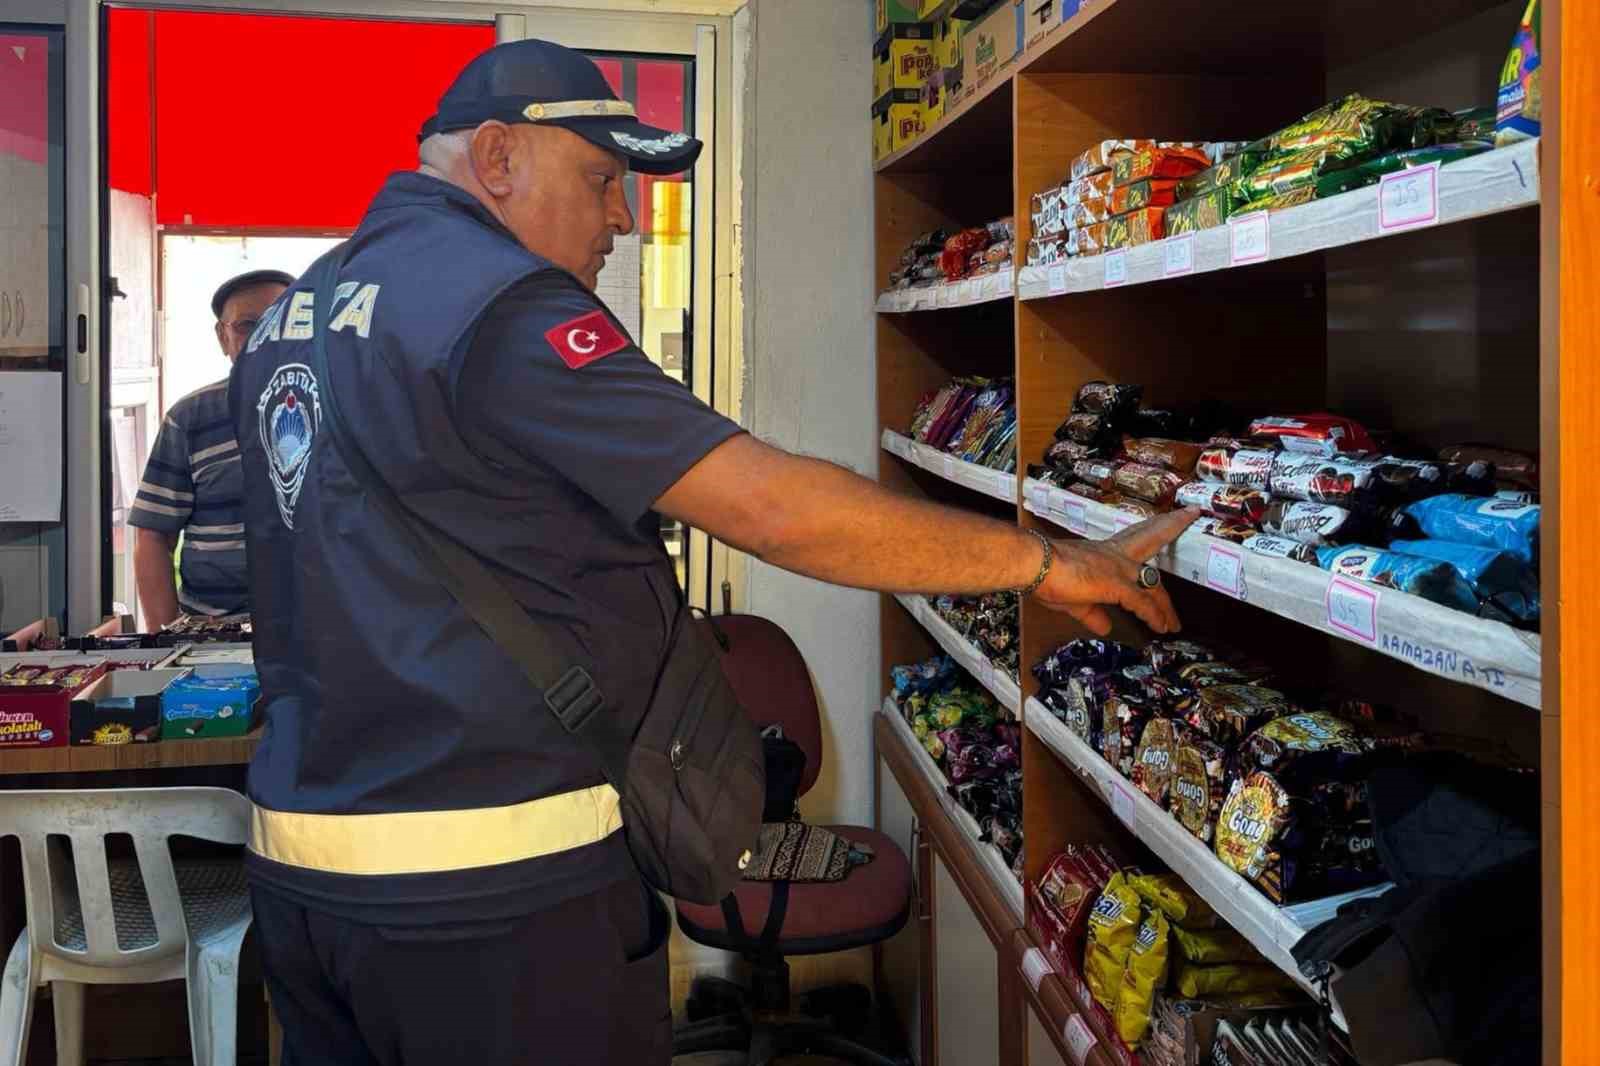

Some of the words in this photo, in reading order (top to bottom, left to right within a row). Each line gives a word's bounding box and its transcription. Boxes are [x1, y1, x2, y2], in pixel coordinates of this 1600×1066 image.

[1383, 633, 1457, 672] RAMAZAN
[1228, 809, 1266, 843] Gong
[1349, 835, 1375, 853] Go
